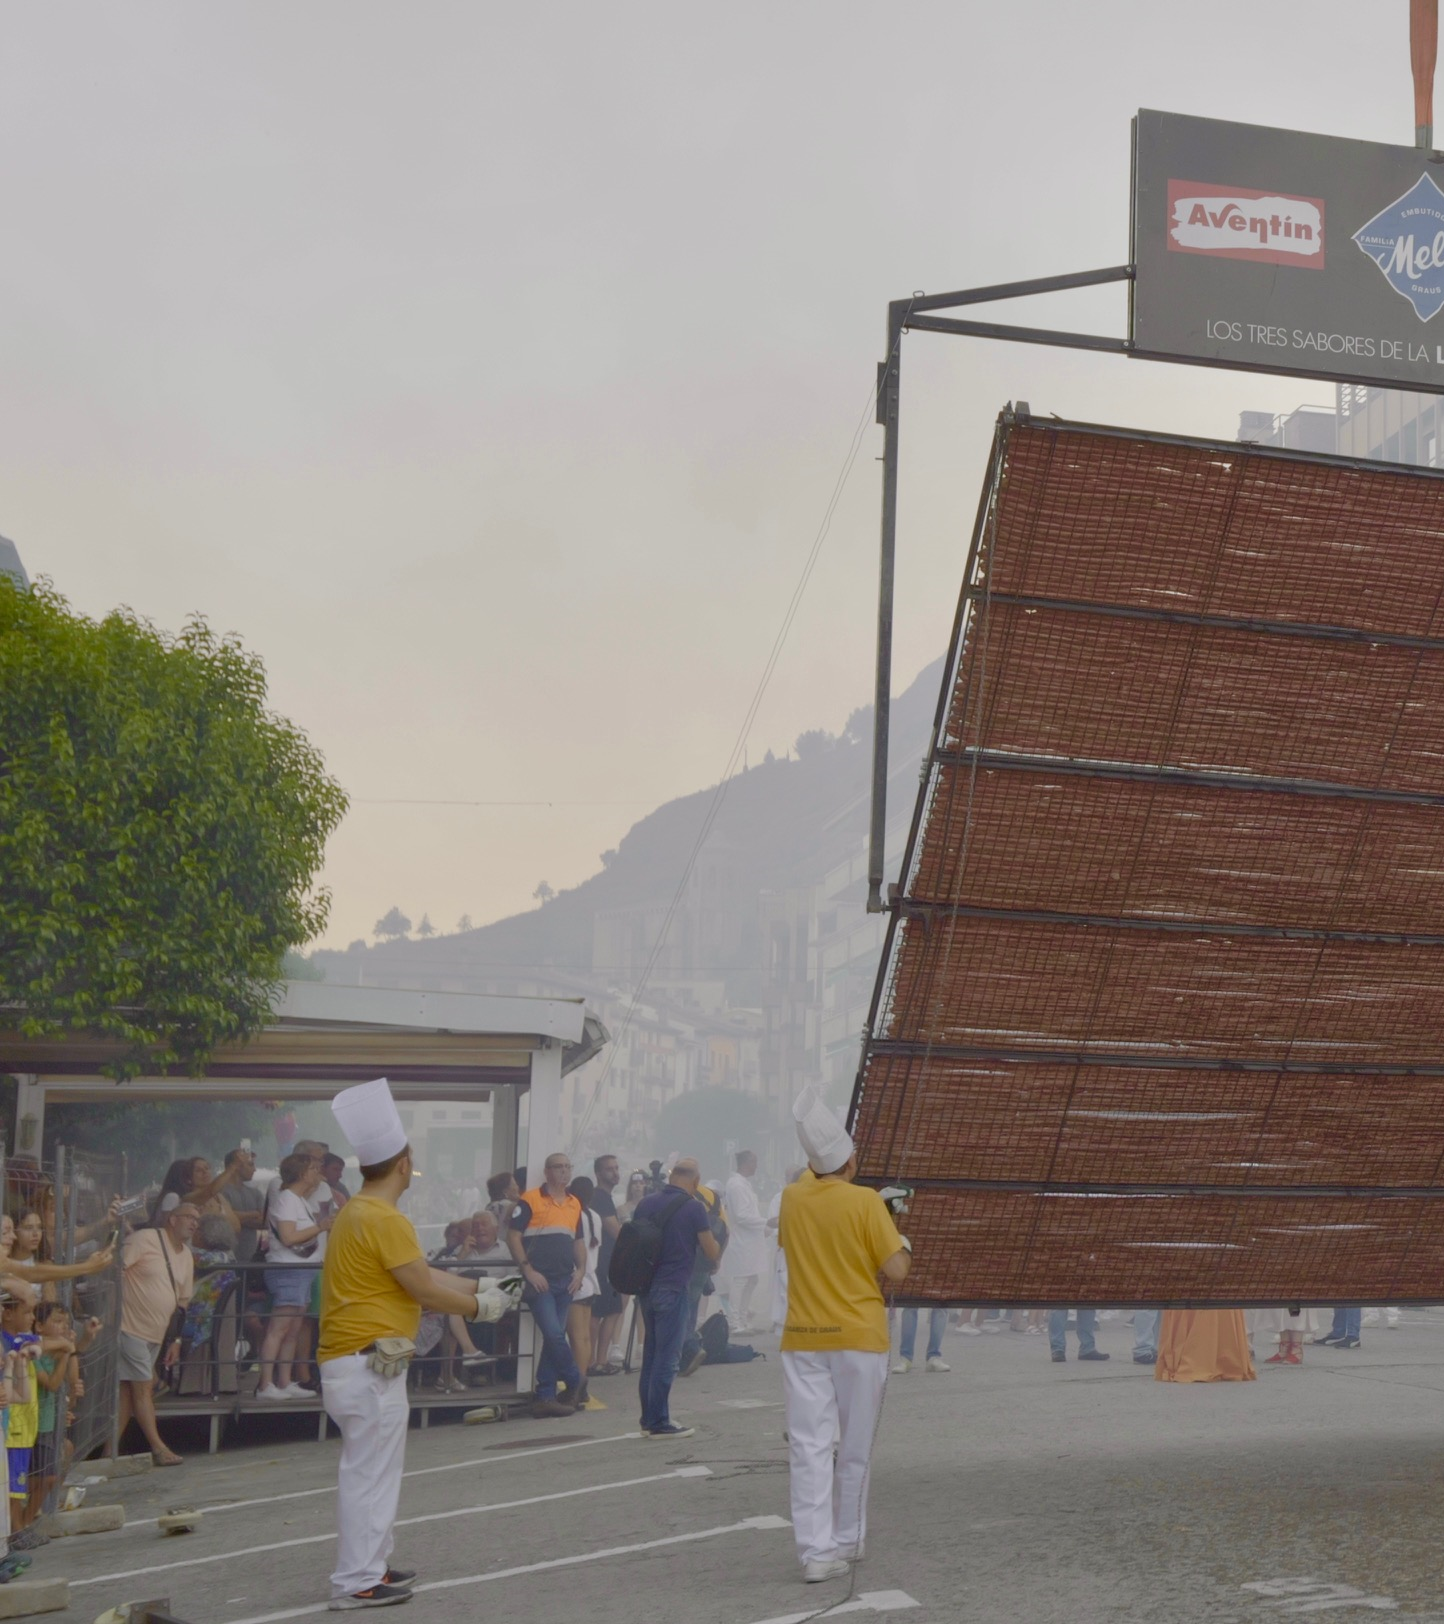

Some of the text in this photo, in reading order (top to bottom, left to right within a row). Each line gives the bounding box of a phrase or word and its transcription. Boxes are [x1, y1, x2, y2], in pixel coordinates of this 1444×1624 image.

[1187, 202, 1313, 244] Aventín
[1360, 235, 1395, 246] FAMILIA
[1411, 284, 1442, 294] GRAUS
[1206, 319, 1243, 342] LOS
[1246, 323, 1288, 347] TRES
[1292, 329, 1376, 357] SABORES
[1380, 339, 1403, 360] DE
[1407, 342, 1430, 363] LA
